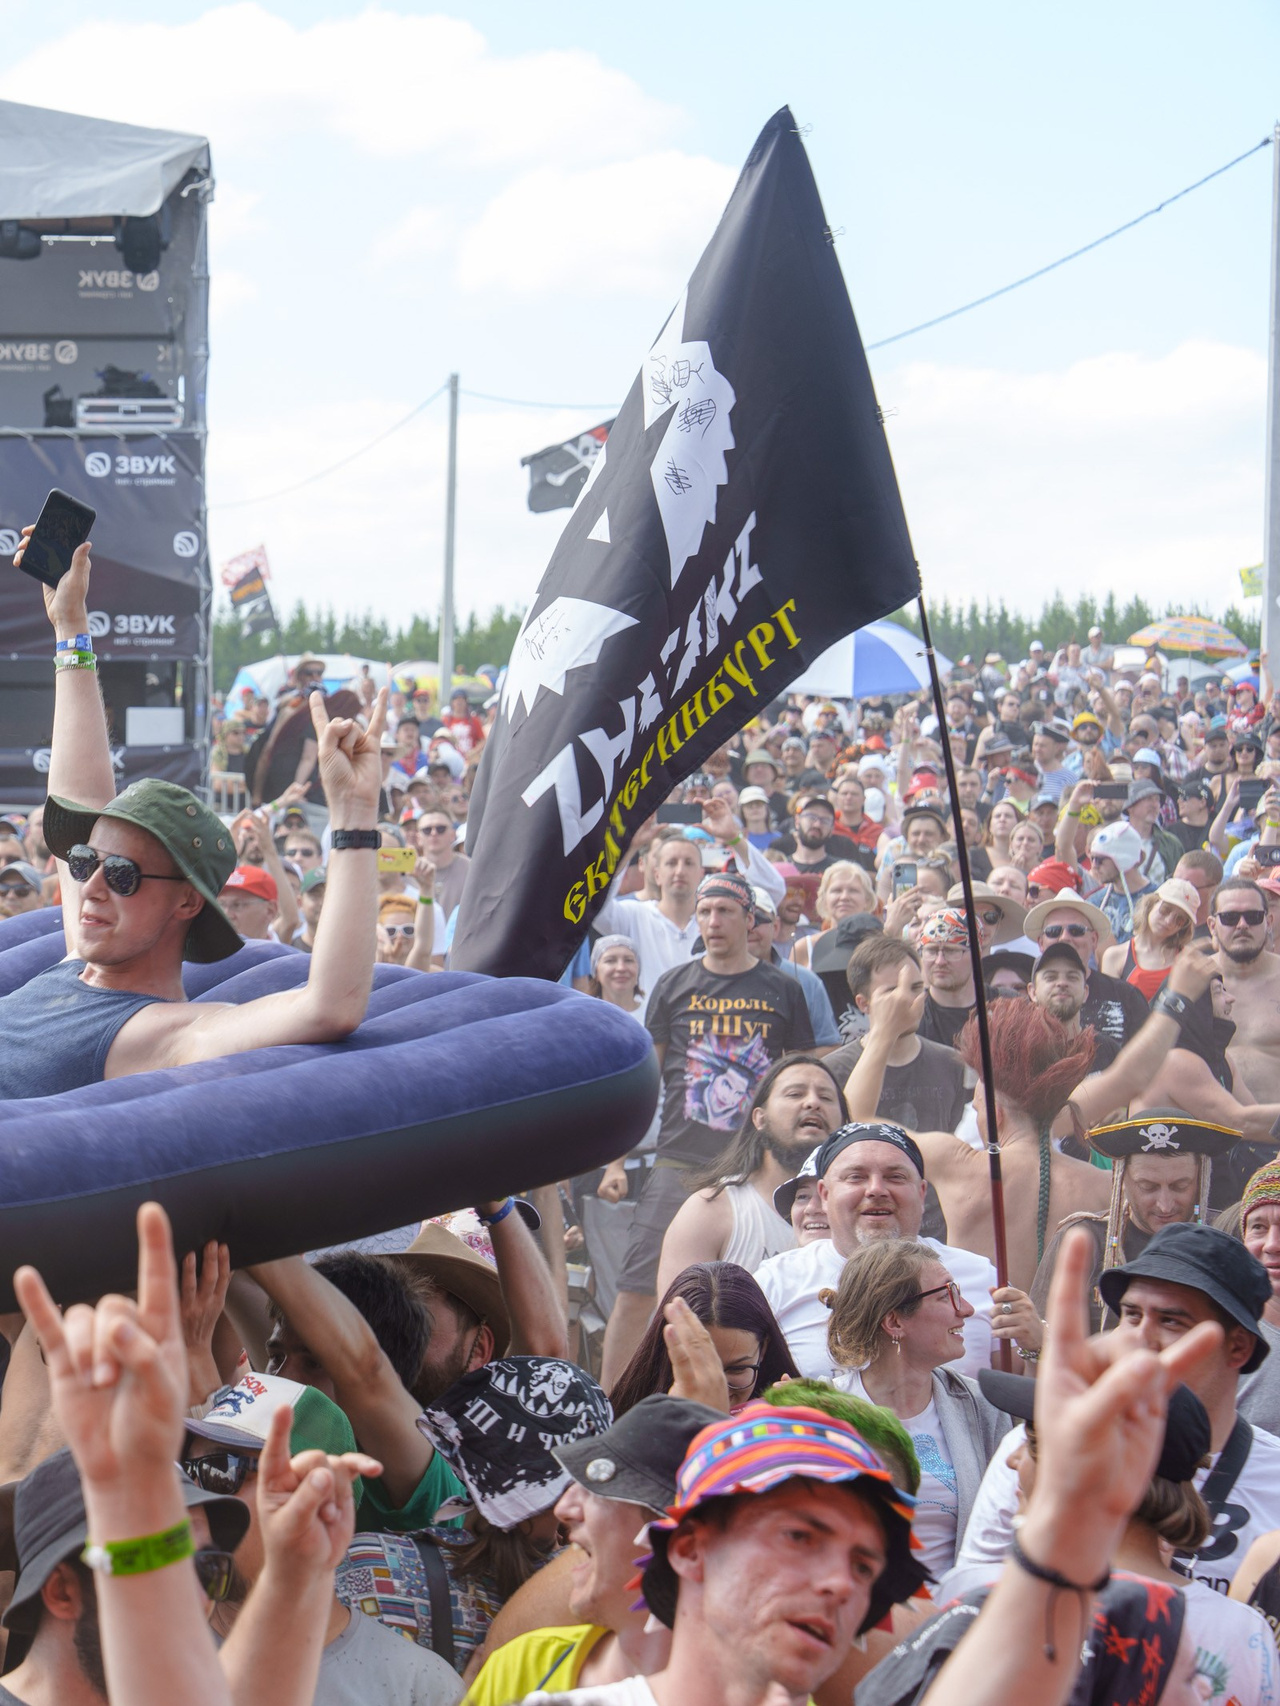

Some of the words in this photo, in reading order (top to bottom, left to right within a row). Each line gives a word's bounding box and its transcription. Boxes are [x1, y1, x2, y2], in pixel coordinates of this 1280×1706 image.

[115, 455, 176, 474] ЗВУК
[114, 614, 176, 634] ЗВУК
[563, 598, 802, 925] ЕКАТЕРИНБУРГ
[689, 1019, 705, 1036] и
[711, 1015, 772, 1043] Шут
